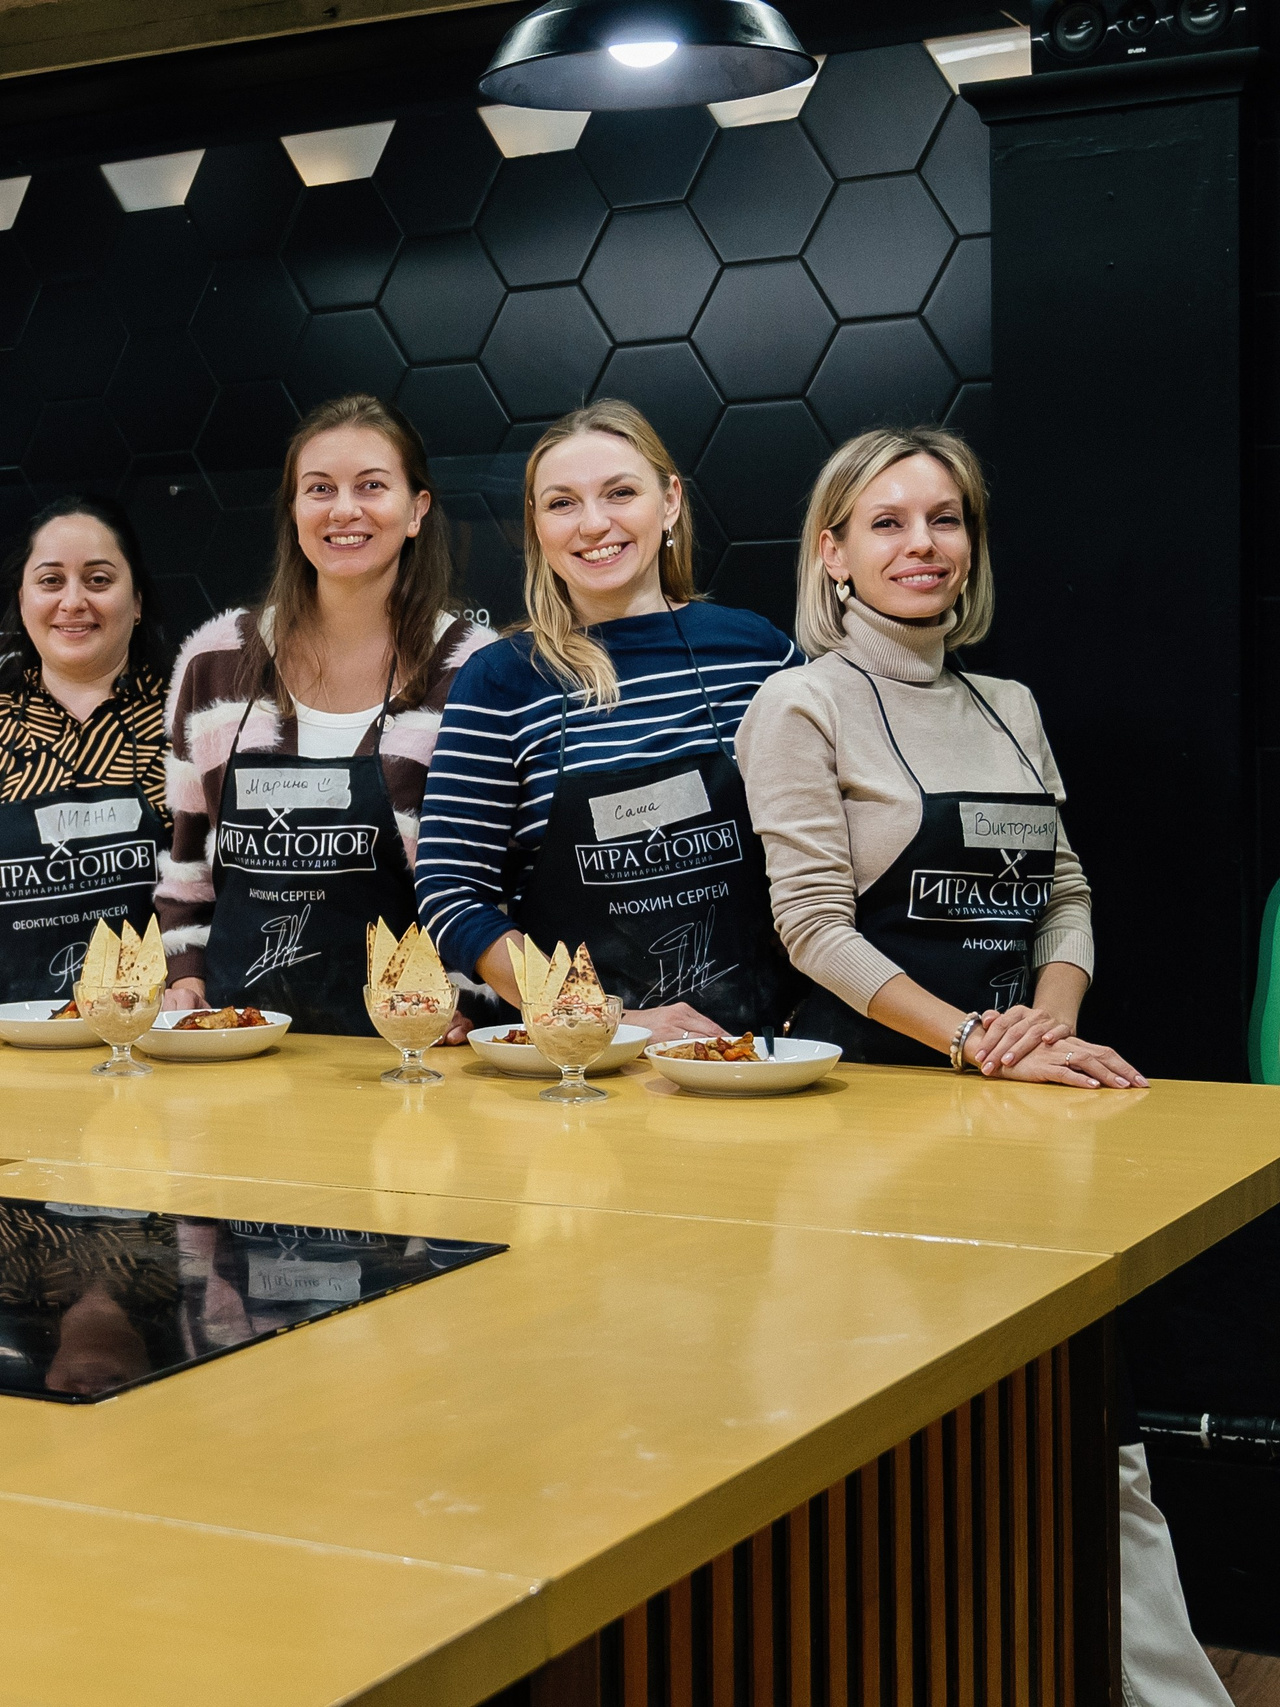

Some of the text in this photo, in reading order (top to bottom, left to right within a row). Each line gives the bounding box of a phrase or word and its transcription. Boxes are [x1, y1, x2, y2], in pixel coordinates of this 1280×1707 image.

[57, 806, 117, 832] ЛИАНА
[614, 802, 661, 820] Саша
[975, 811, 1048, 844] Виктория
[220, 827, 369, 857] ИГРА СТОЛОВ
[581, 827, 734, 871] ИГРА СТОЛОВ
[46, 846, 151, 882] СТОЛОВ
[292, 859, 337, 868] СТУДИЯ
[604, 854, 713, 879] КУЛИНАРНАЯ СТУДИЯ
[5, 874, 122, 898] КУЛИНАРНАЯ СТУДИЯ
[249, 888, 326, 902] АНОХИН СЕРГЕЙ
[608, 881, 730, 915] АНОХИН СЕРГЕЙ
[919, 877, 1054, 907] ИГРА СТОЛ
[12, 905, 129, 931] ФЕОКТИСТОВ АЛЕКСЕЙ
[947, 906, 1021, 916] КУЛИНАРНАЯ
